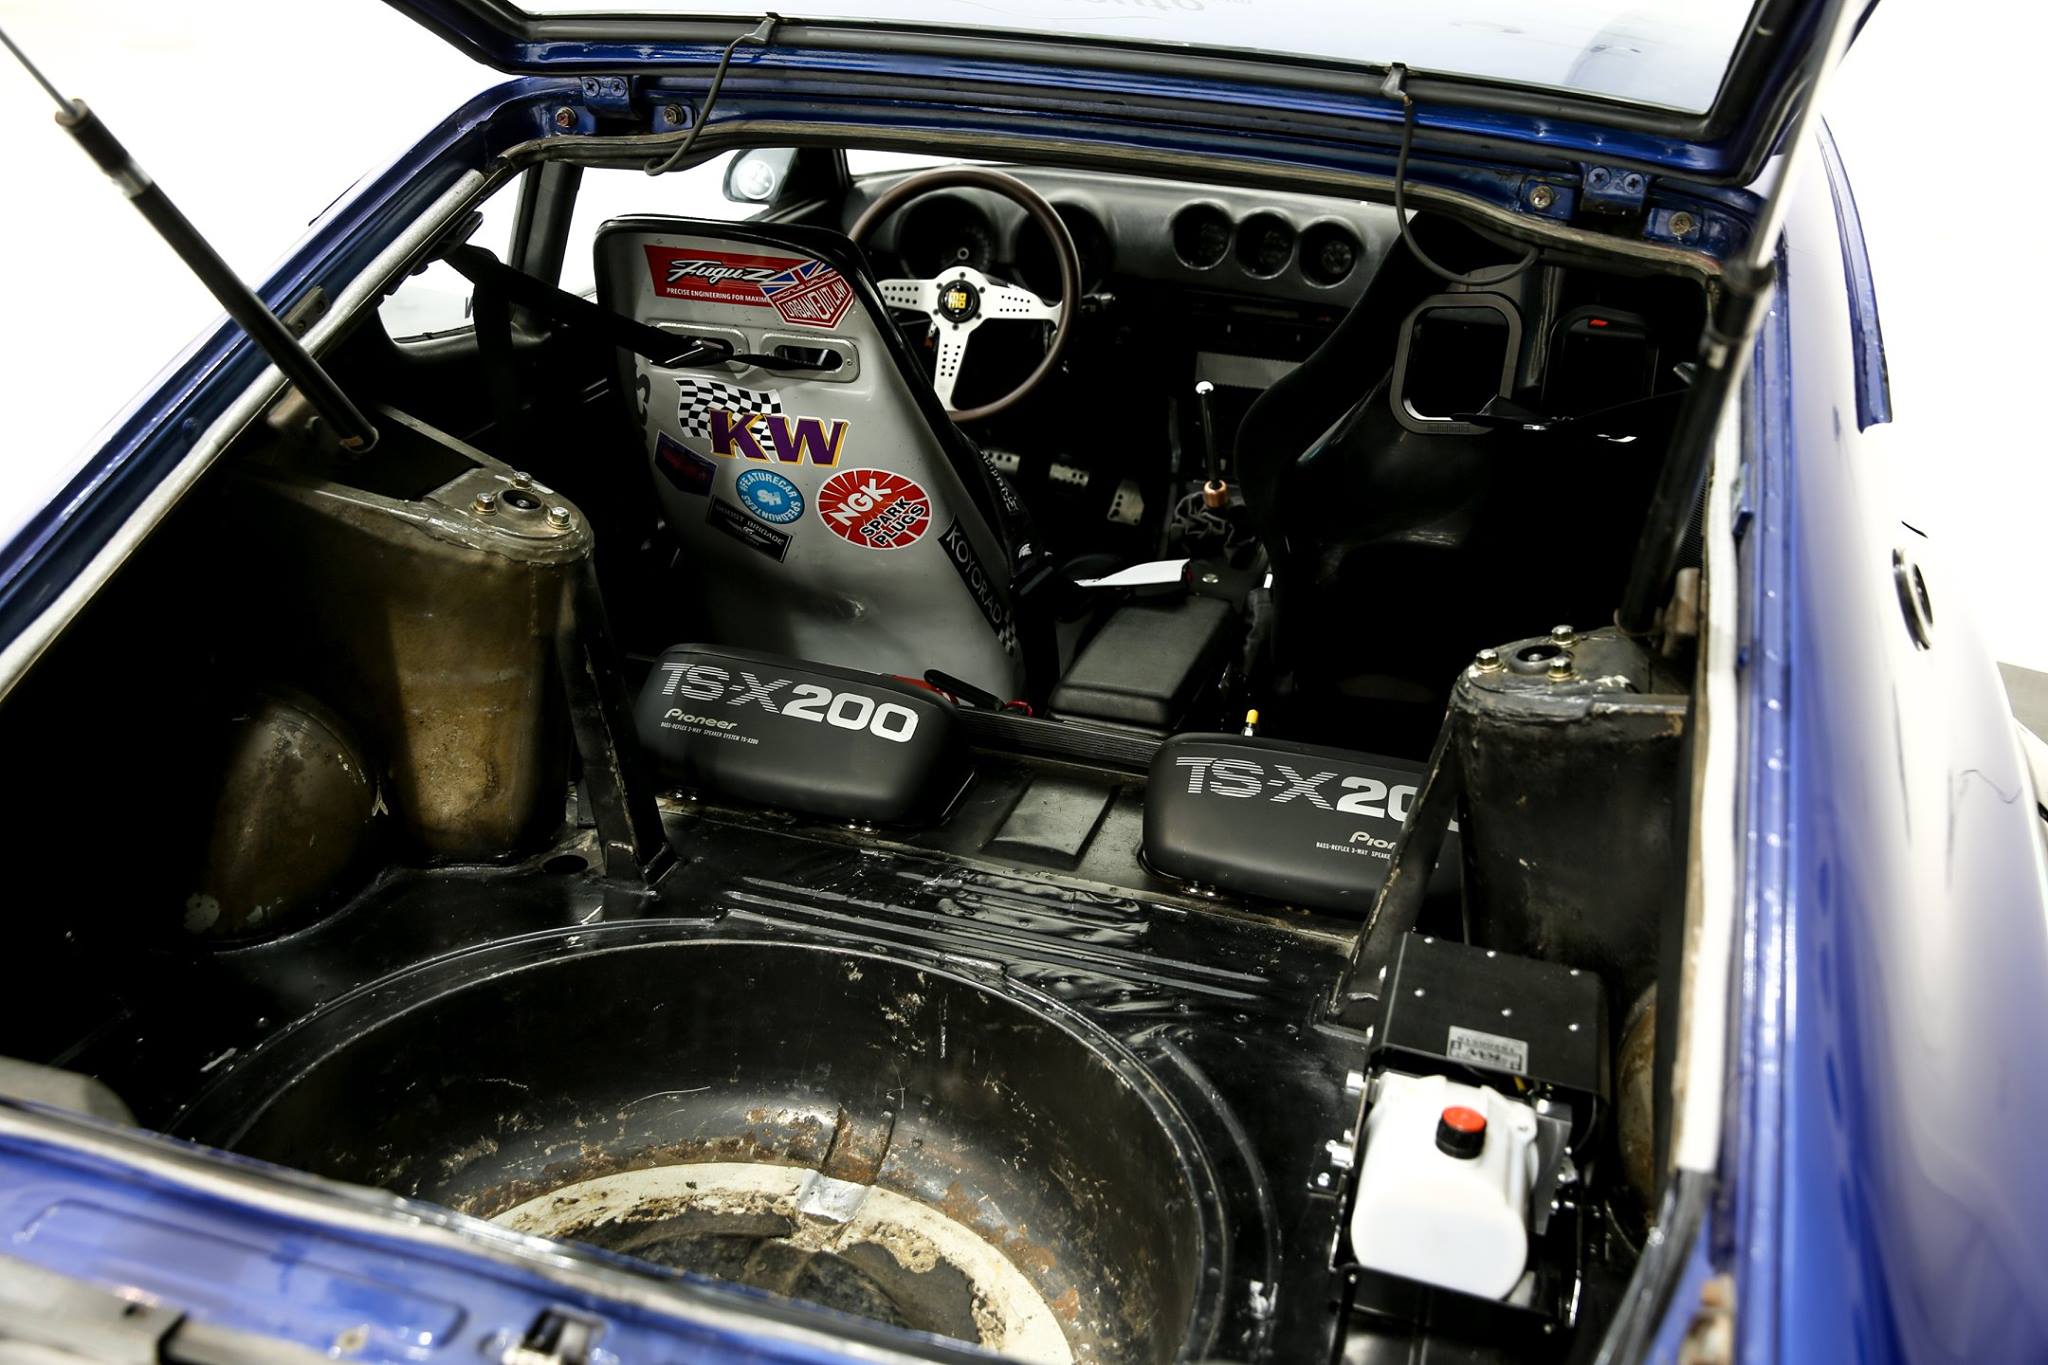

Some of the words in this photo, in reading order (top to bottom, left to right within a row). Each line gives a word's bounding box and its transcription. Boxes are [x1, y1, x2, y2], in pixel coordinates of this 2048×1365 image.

[666, 287, 690, 297] PRECISE
[691, 290, 731, 300] ENGINEERING
[732, 293, 744, 301] FOR
[708, 408, 851, 468] KW
[741, 494, 801, 522] SPEEDHUNTERS
[828, 478, 892, 527] NGK
[860, 496, 912, 538] SPARK
[872, 504, 926, 547] PLUGS
[946, 525, 1003, 624] KOYORAD
[661, 662, 919, 743] TS-X200
[664, 708, 738, 730] Pioneer
[660, 721, 688, 731] BASS-REFLEX
[703, 729, 722, 738] SPEAKER
[722, 732, 740, 741] SYSTEM
[1175, 756, 1459, 832] TS-X20
[1316, 841, 1350, 853] BASS-REFLEX
[1371, 850, 1392, 860] SPEAKE
